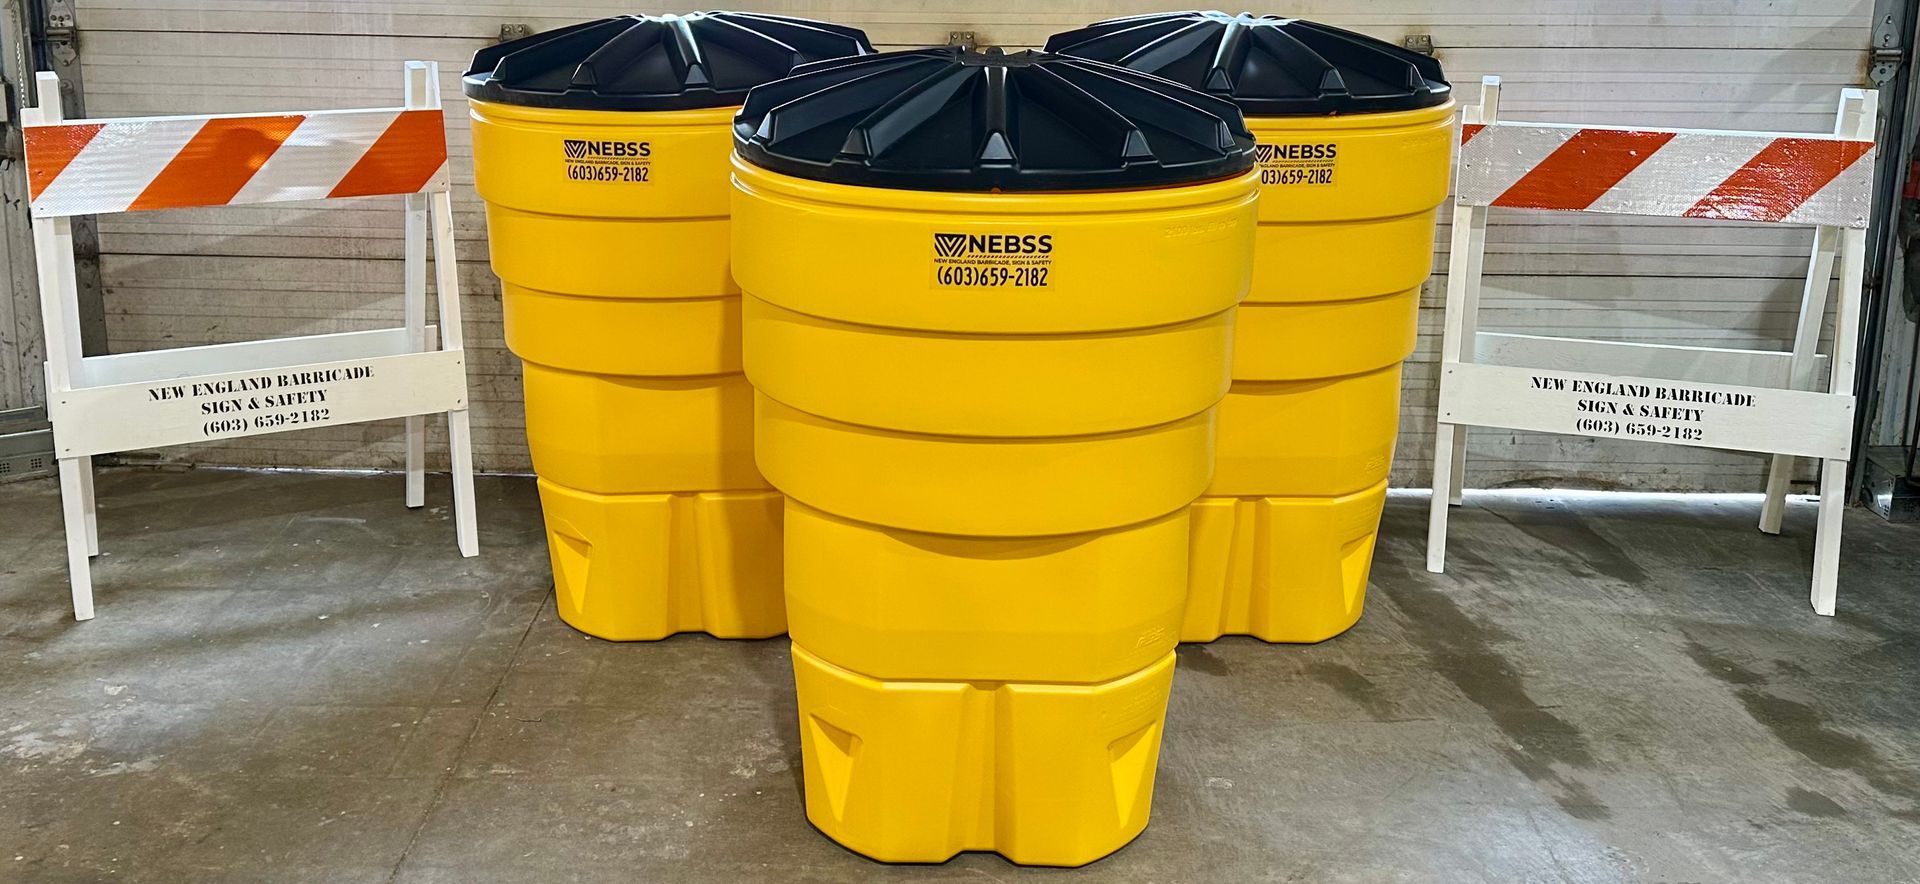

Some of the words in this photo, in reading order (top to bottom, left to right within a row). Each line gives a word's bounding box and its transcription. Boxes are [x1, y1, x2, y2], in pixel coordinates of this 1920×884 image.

[588, 141, 650, 156] NEBSS
[1274, 144, 1336, 159] NEBSS
[568, 165, 649, 181] (603)659-2182
[969, 235, 1053, 253] NEBSS
[938, 266, 1048, 286] (603)659-2182
[149, 385, 186, 401] NEW
[192, 377, 272, 397] ENGLAND
[277, 365, 374, 387] BARRICADE
[1531, 376, 1568, 391] NEW
[1572, 380, 1651, 398] ENGLAND
[1655, 387, 1756, 408] BARRICADE
[201, 399, 243, 416] SIGN
[248, 397, 260, 410] &
[265, 389, 328, 408] SAFETY
[1577, 399, 1618, 415] SIGN
[1622, 403, 1635, 416] &
[1639, 405, 1704, 422] SAFETY
[203, 417, 248, 437] (603)
[254, 408, 331, 429] 659-2182
[1576, 418, 1620, 435] (603)
[1626, 422, 1703, 441] 659-2182
